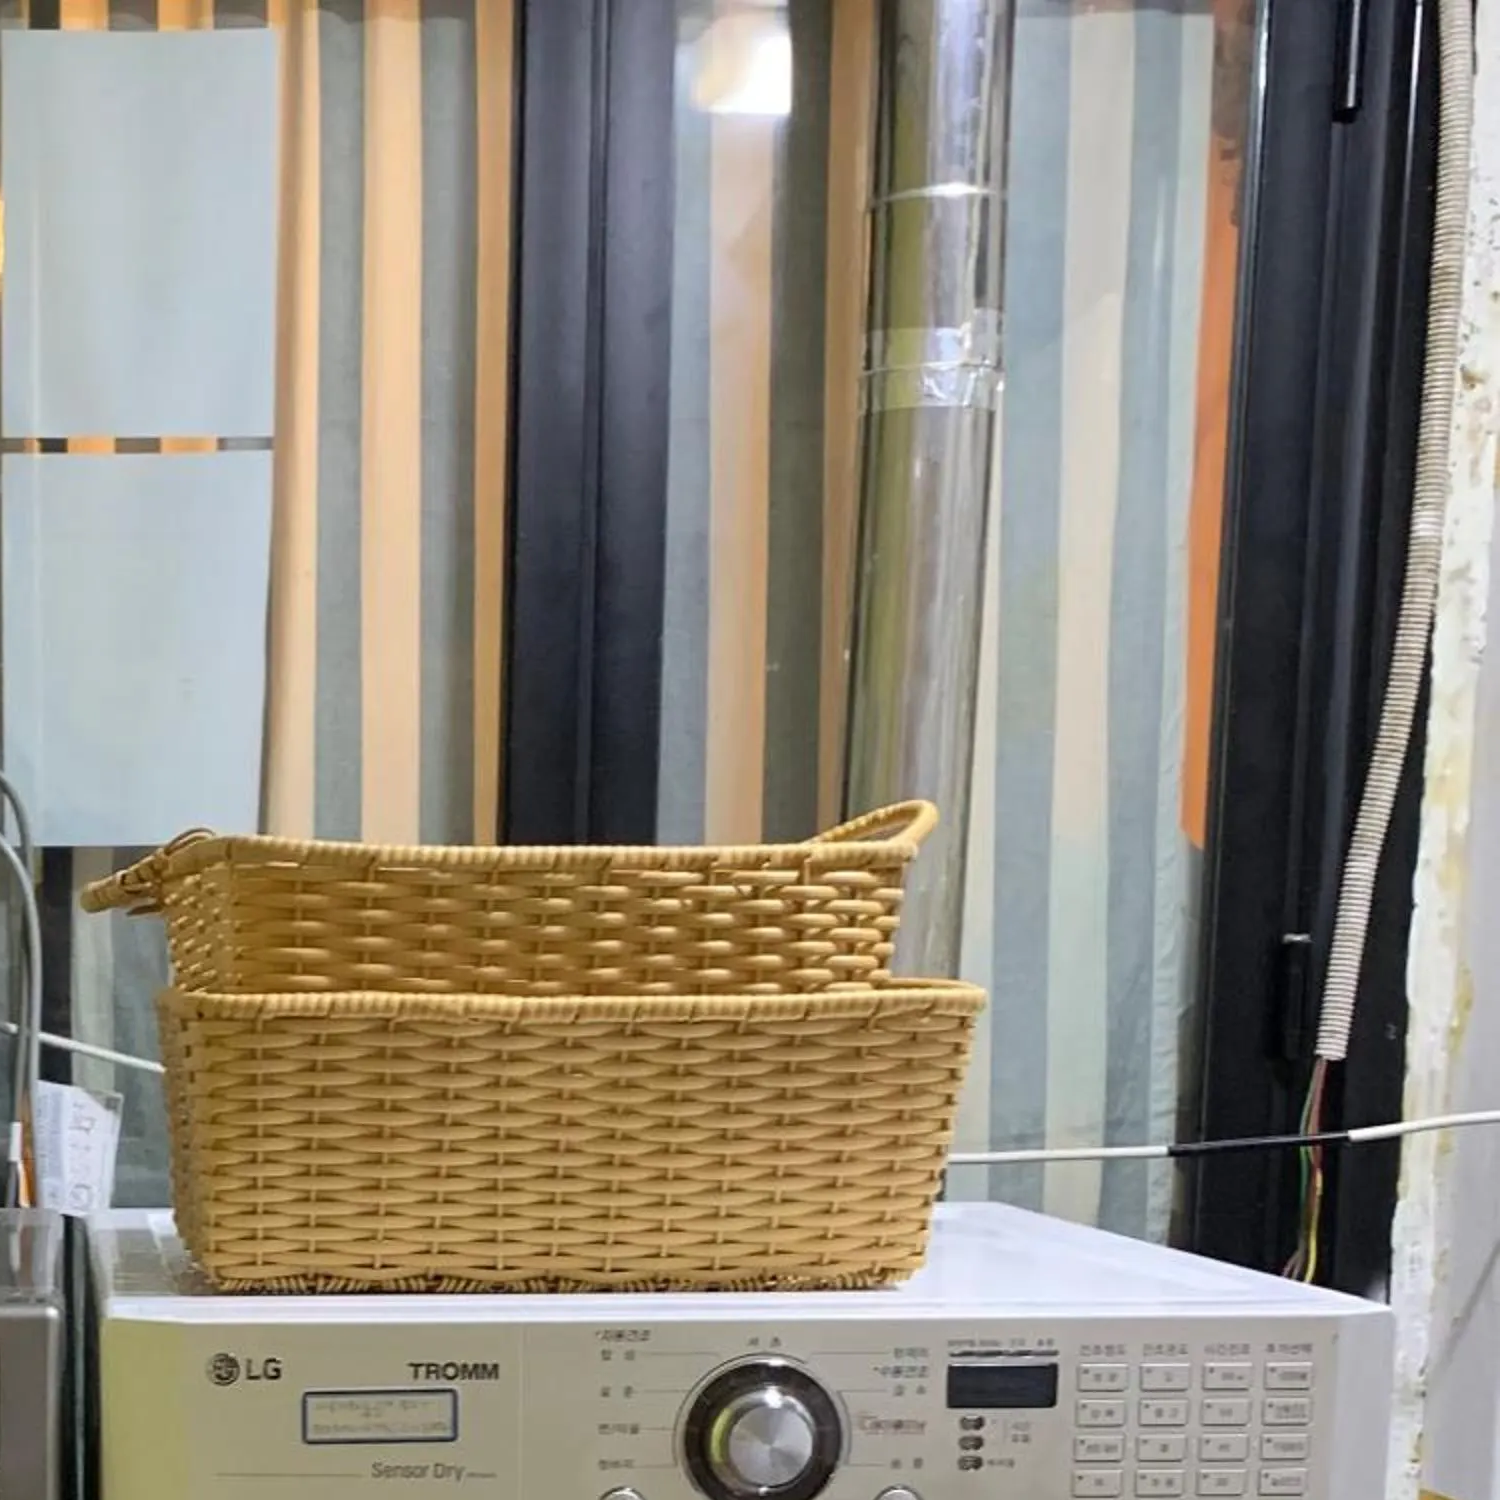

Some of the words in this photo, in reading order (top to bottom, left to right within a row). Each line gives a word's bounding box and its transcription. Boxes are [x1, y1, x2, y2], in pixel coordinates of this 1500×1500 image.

[245, 1357, 282, 1381] LG
[408, 1361, 500, 1381] TROMM
[371, 1460, 429, 1479] Sensor
[433, 1462, 466, 1482] Dry
